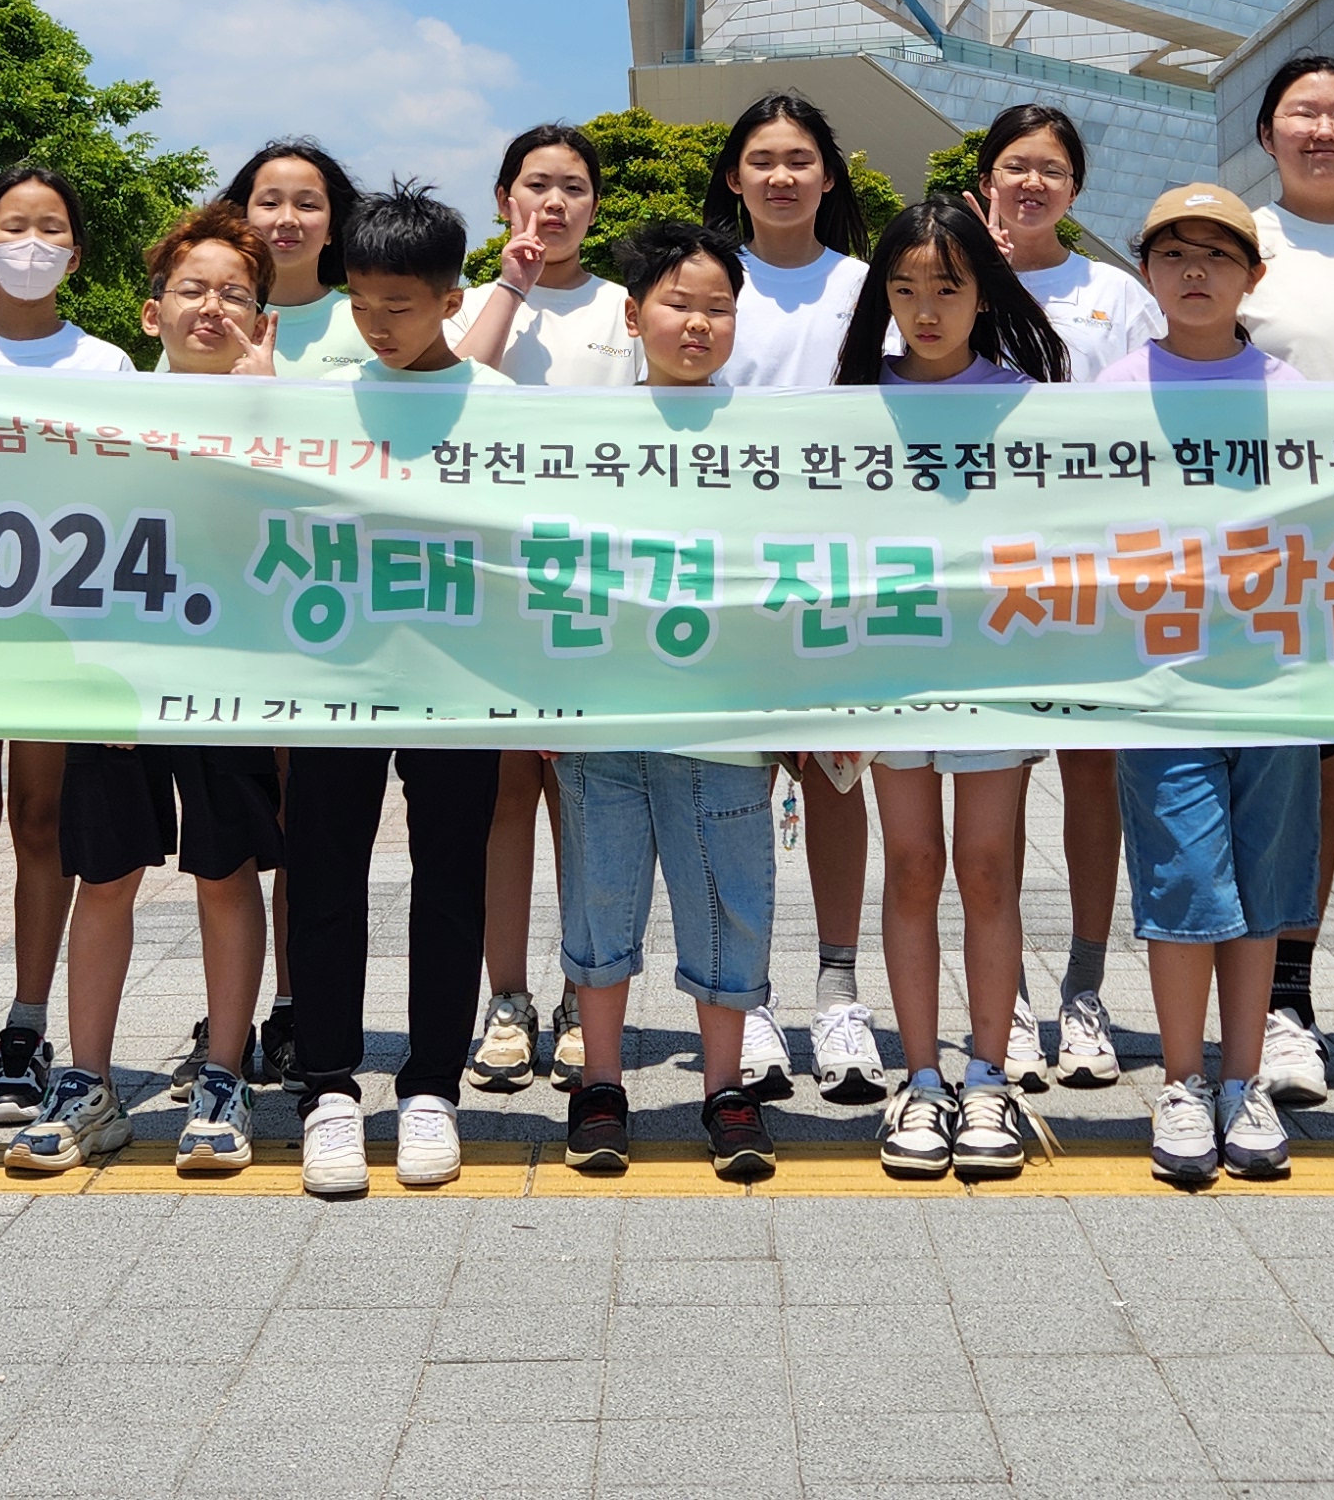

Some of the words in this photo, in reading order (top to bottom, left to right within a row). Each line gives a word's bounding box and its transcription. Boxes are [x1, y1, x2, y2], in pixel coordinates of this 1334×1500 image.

[431, 439, 781, 491] 합천교육지원청
[799, 439, 1157, 492] 환경중점학교와
[251, 517, 477, 646] 생태
[519, 520, 715, 659] 환경
[762, 540, 945, 651] 진로
